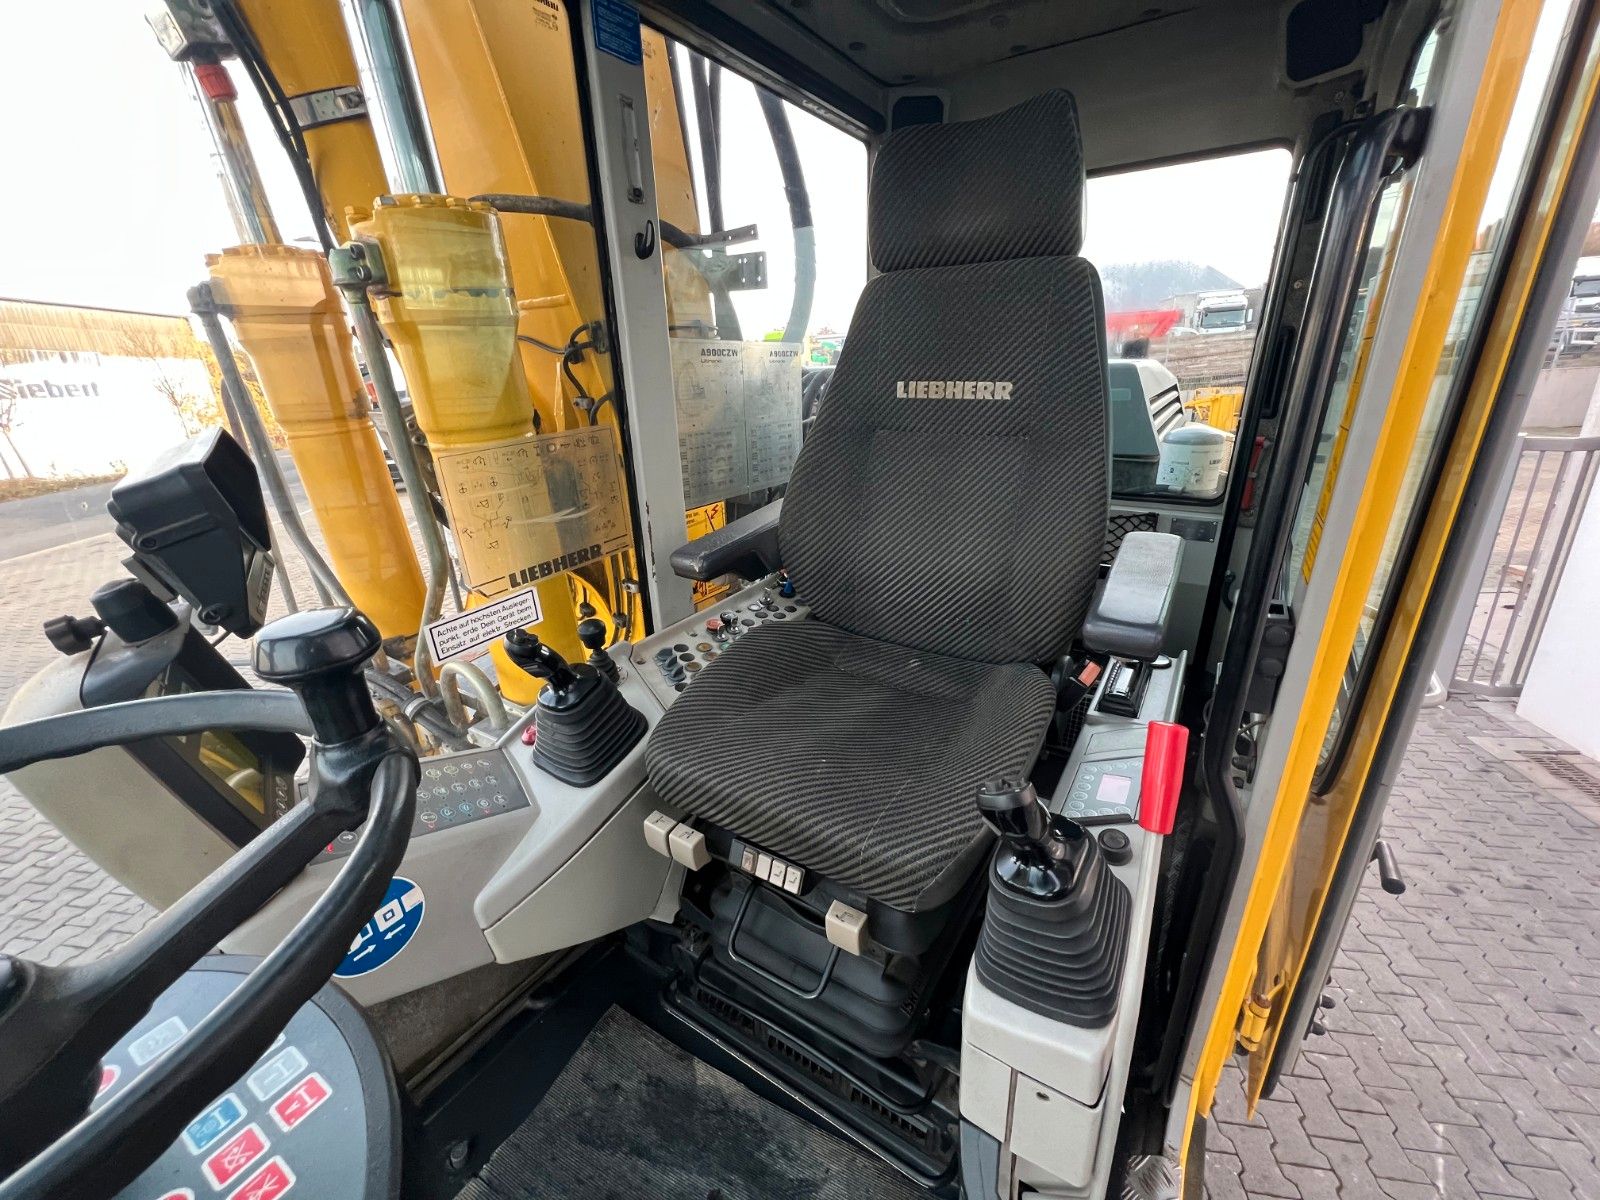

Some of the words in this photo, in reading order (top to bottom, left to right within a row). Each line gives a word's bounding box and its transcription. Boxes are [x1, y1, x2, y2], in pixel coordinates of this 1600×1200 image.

[896, 380, 1013, 400] LIEBHERR
[509, 543, 603, 588] LIEBHERR
[437, 625, 458, 638] Achte
[459, 620, 470, 629] auf
[463, 627, 479, 637] erde
[481, 619, 496, 629] Dein
[517, 605, 532, 615] beim
[441, 641, 466, 655] Einsatz
[469, 635, 480, 643] auf
